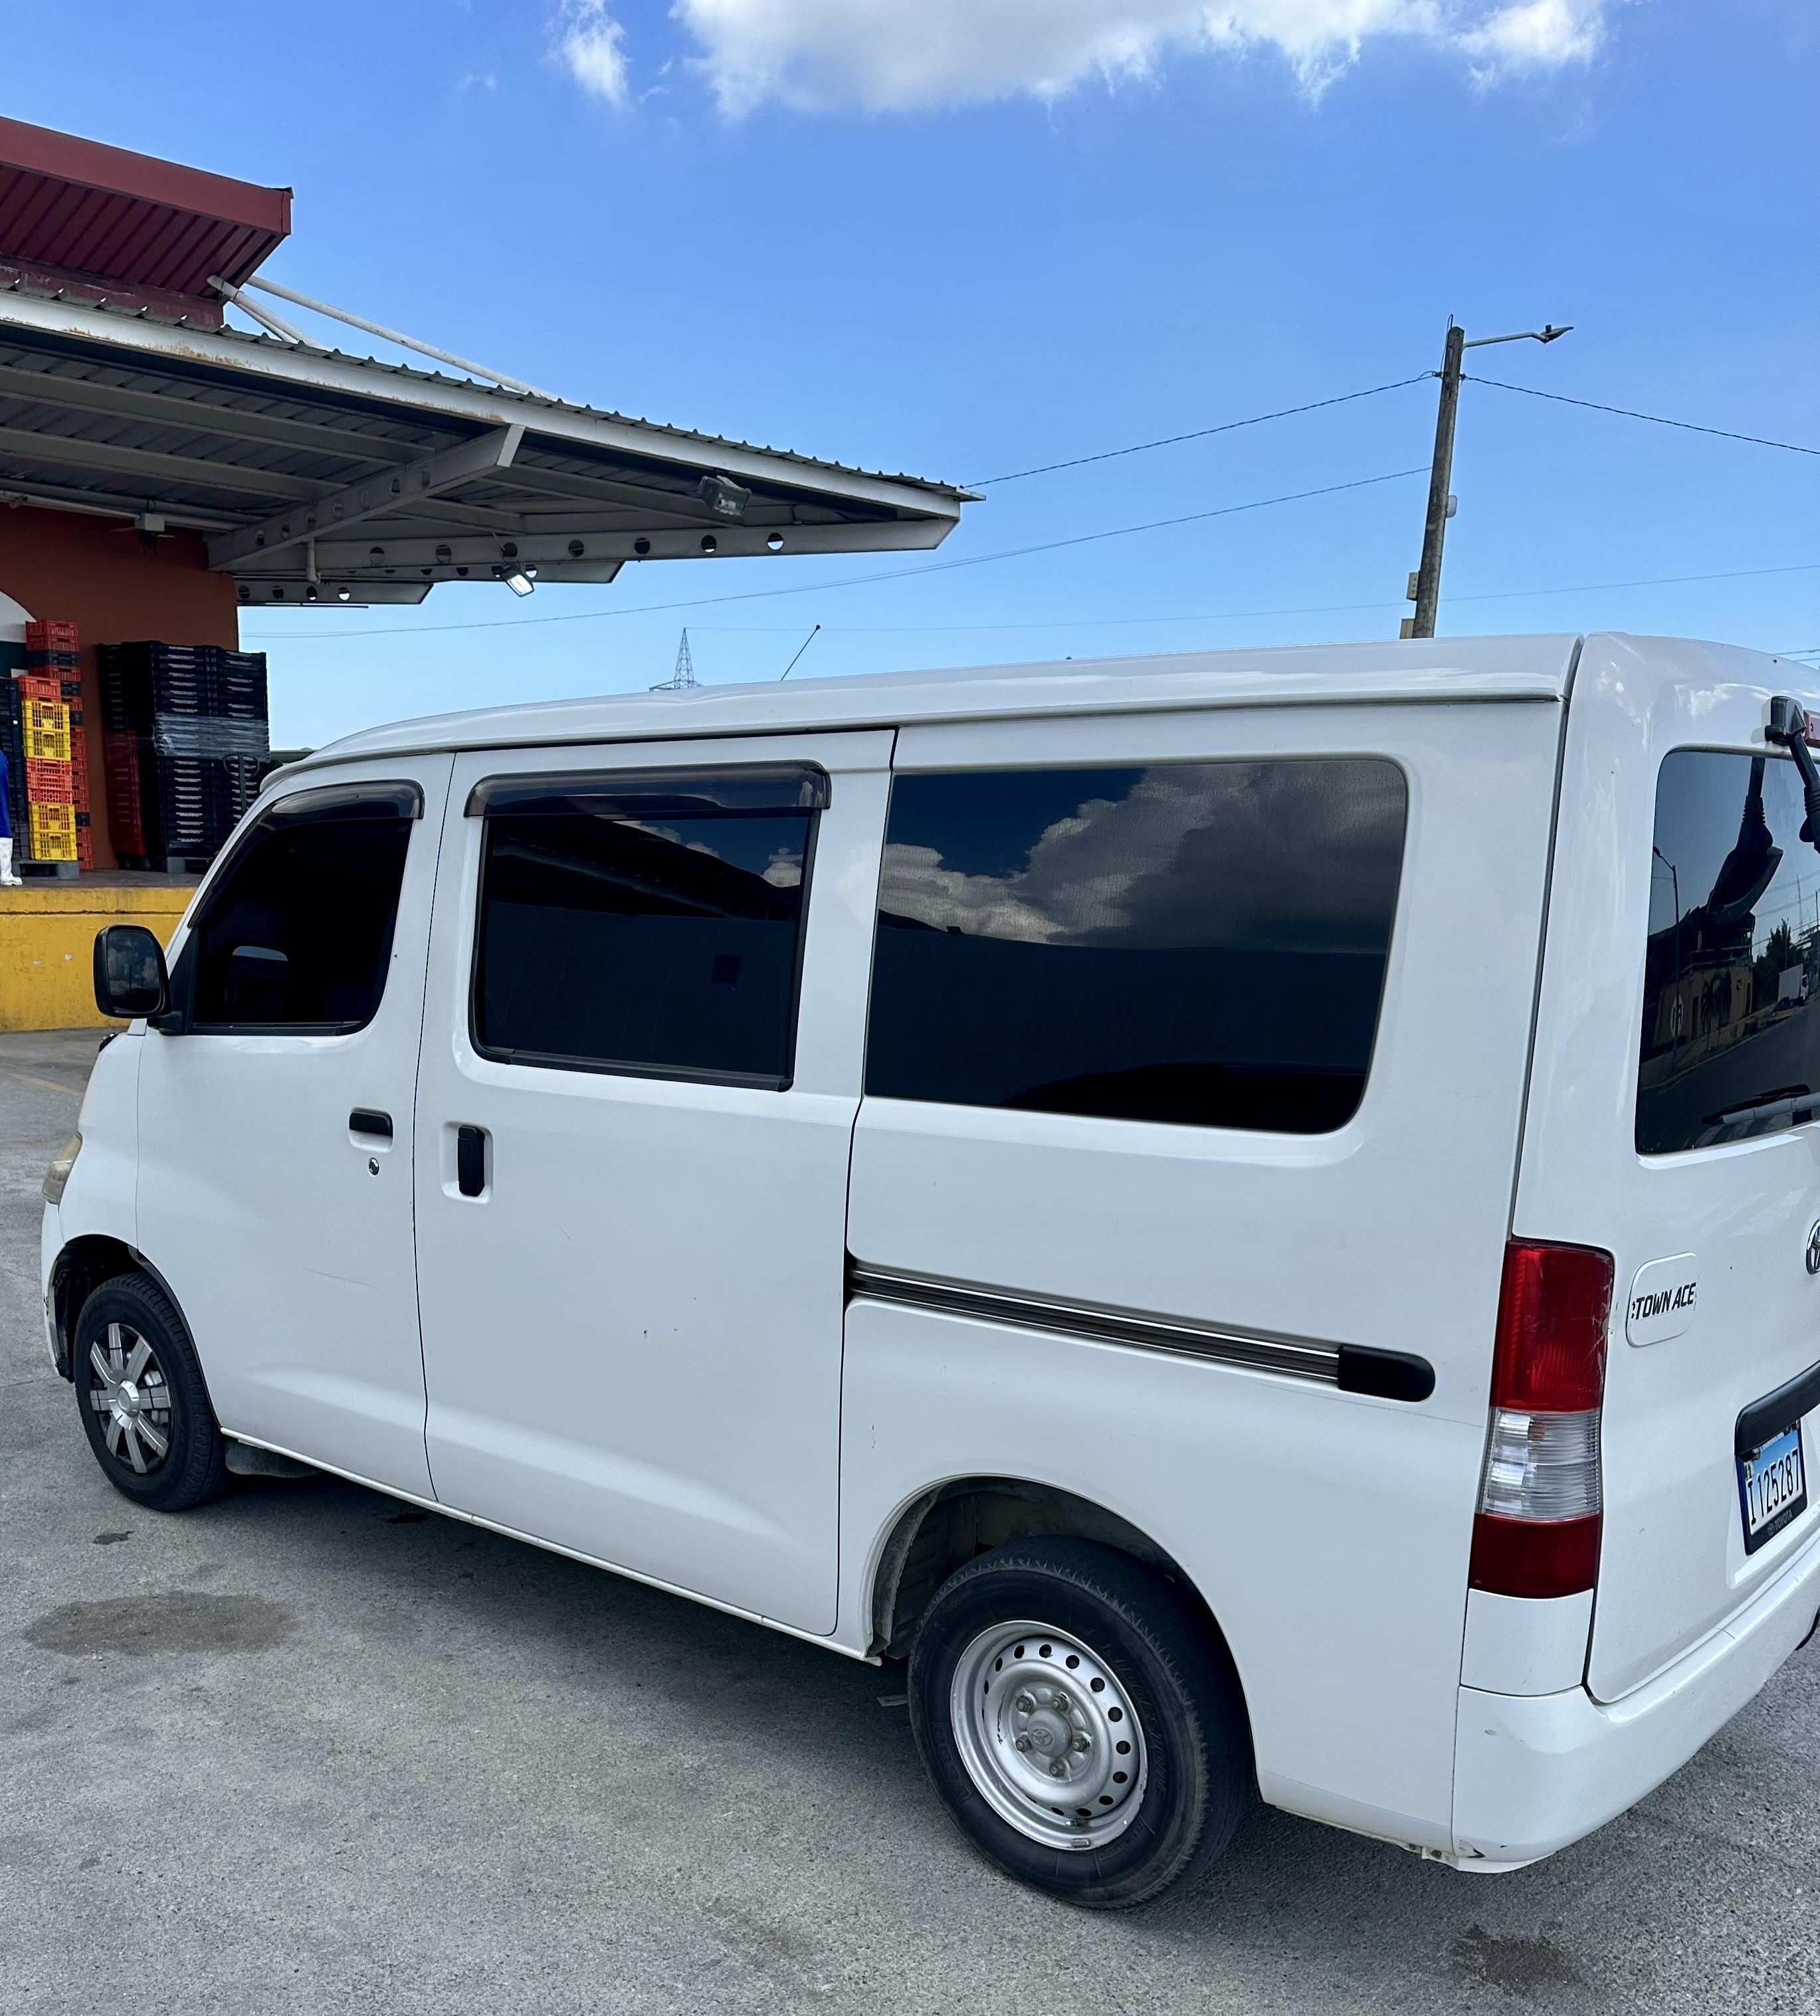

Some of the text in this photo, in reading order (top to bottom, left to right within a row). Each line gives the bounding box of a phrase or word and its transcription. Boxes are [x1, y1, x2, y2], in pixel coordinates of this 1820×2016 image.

[1635, 1282, 1696, 1320] TOWN ACE
[1775, 1509, 1793, 1531] TOYOTA
